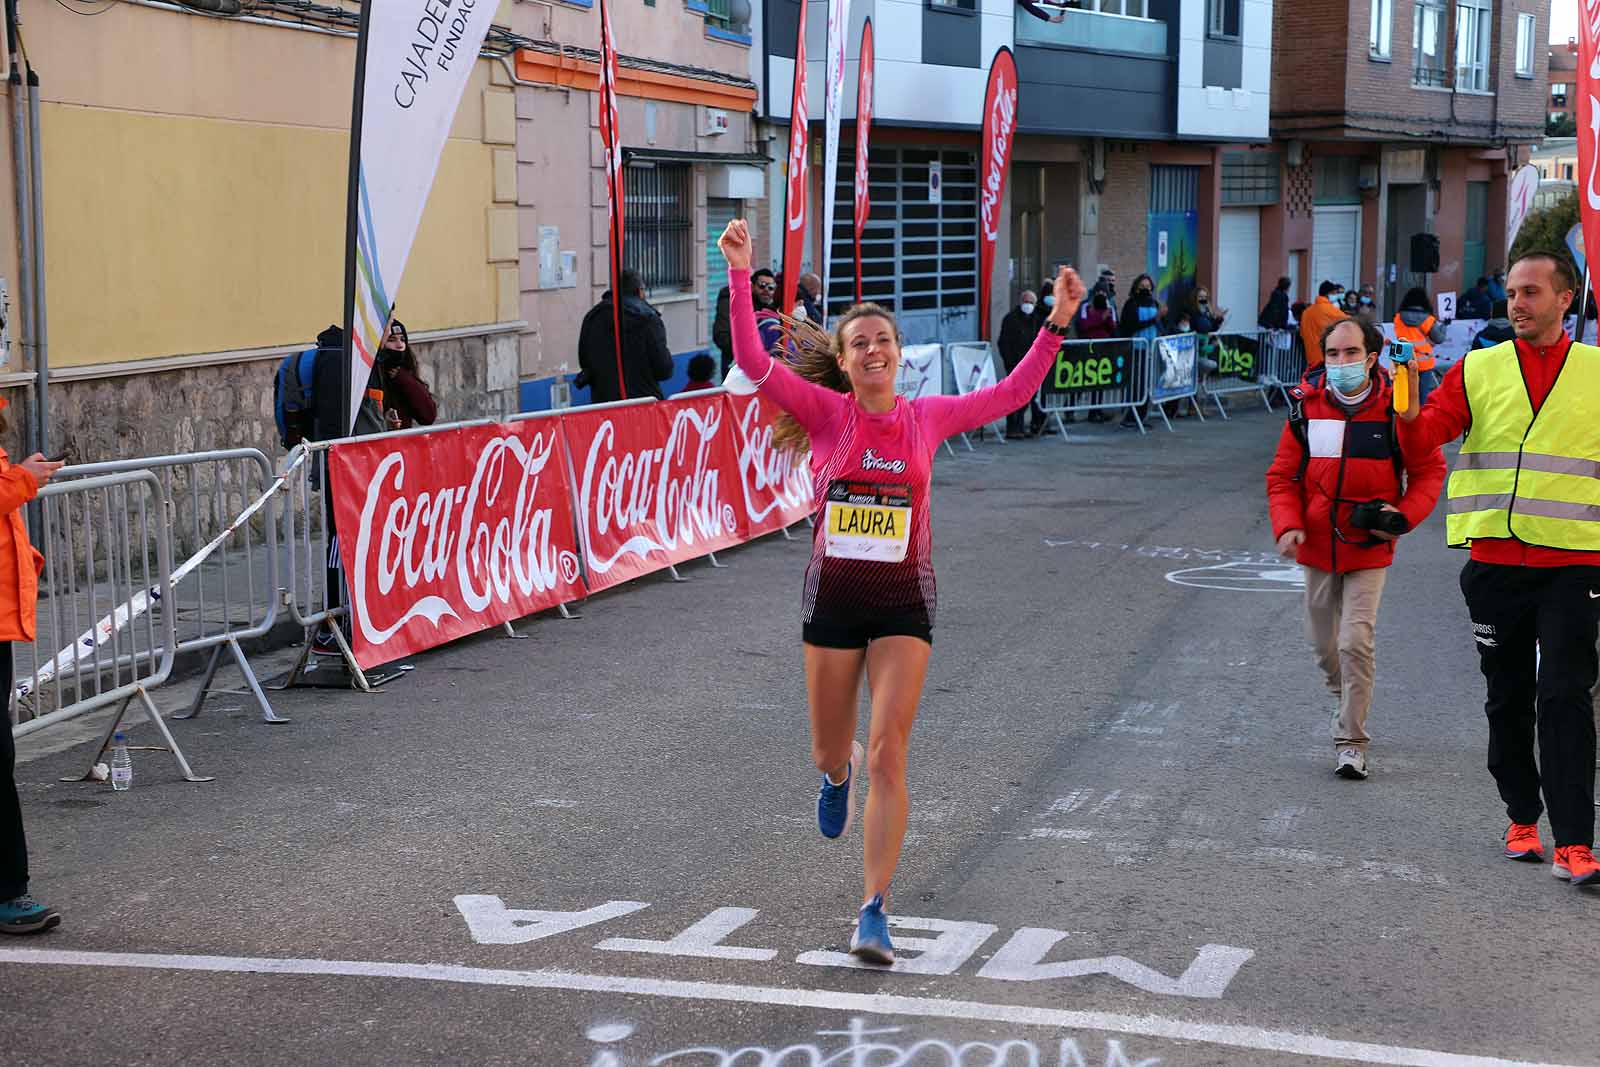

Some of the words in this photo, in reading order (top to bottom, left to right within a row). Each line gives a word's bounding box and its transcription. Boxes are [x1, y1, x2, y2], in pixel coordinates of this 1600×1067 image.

[394, 0, 452, 108] CAJADE
[1444, 297, 1452, 311] 2
[355, 428, 558, 645] Coca-Cola
[580, 405, 723, 574] Coca-Cola
[838, 508, 896, 537] LAURA
[453, 894, 1254, 998] META
